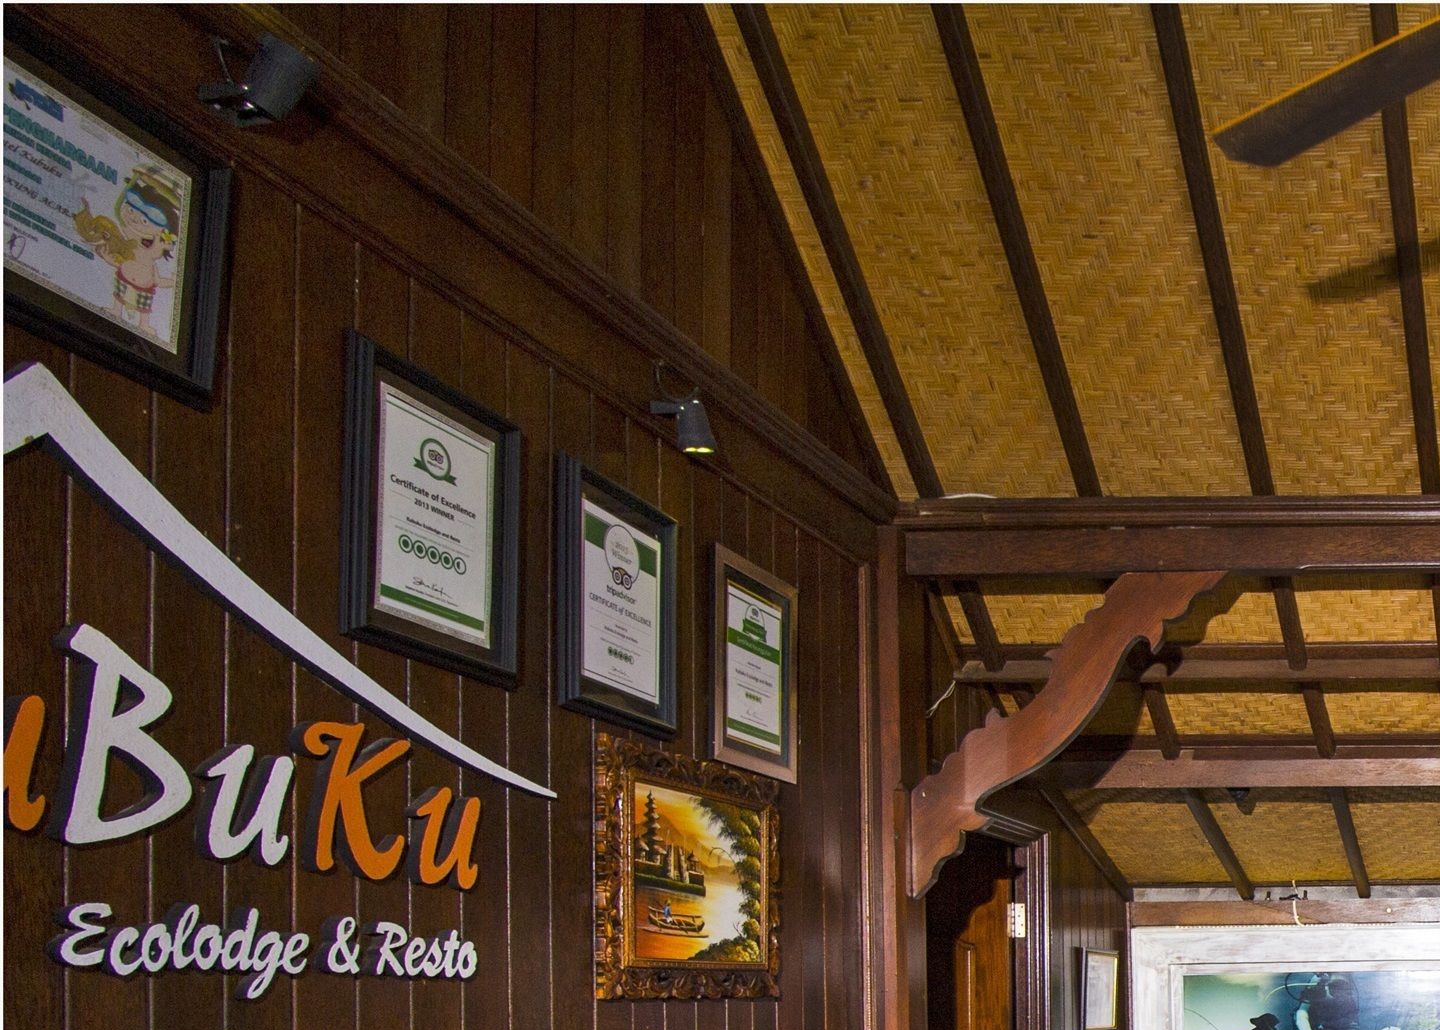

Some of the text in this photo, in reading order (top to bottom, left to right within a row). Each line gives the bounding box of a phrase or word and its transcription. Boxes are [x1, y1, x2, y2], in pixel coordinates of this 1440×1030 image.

[390, 473, 430, 497] Certificate
[441, 497, 476, 520] Excellence
[414, 498, 455, 521] 2013 WINNER
[60, 903, 477, 999] Ecolodge & Resto
